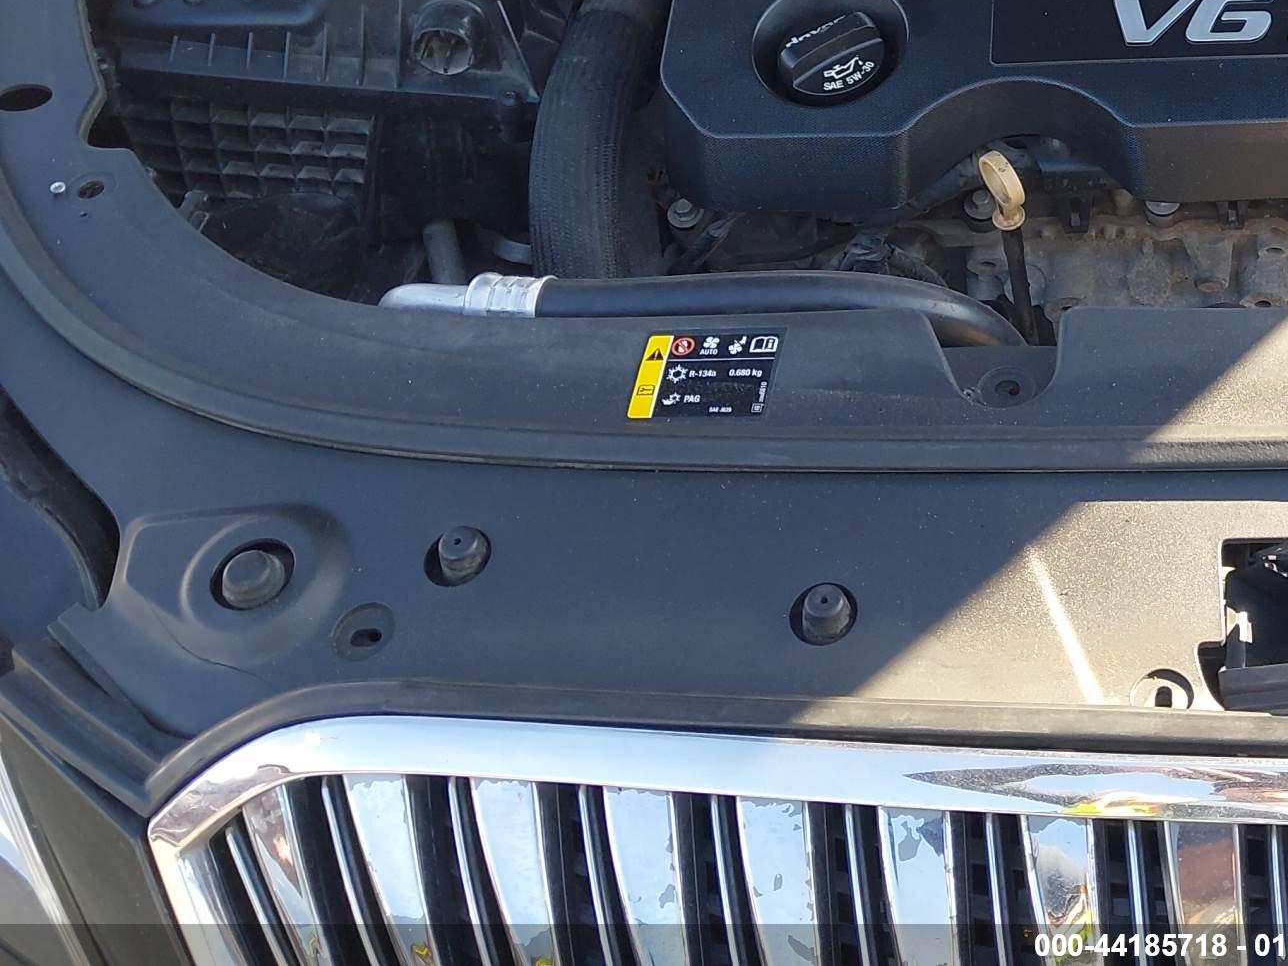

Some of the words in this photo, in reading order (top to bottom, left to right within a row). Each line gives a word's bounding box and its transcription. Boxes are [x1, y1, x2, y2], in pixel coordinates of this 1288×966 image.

[823, 79, 844, 91] SAE
[845, 61, 875, 85] 5W-30
[688, 369, 717, 378] R-134a
[752, 369, 762, 377] kg
[683, 395, 701, 403] PAG
